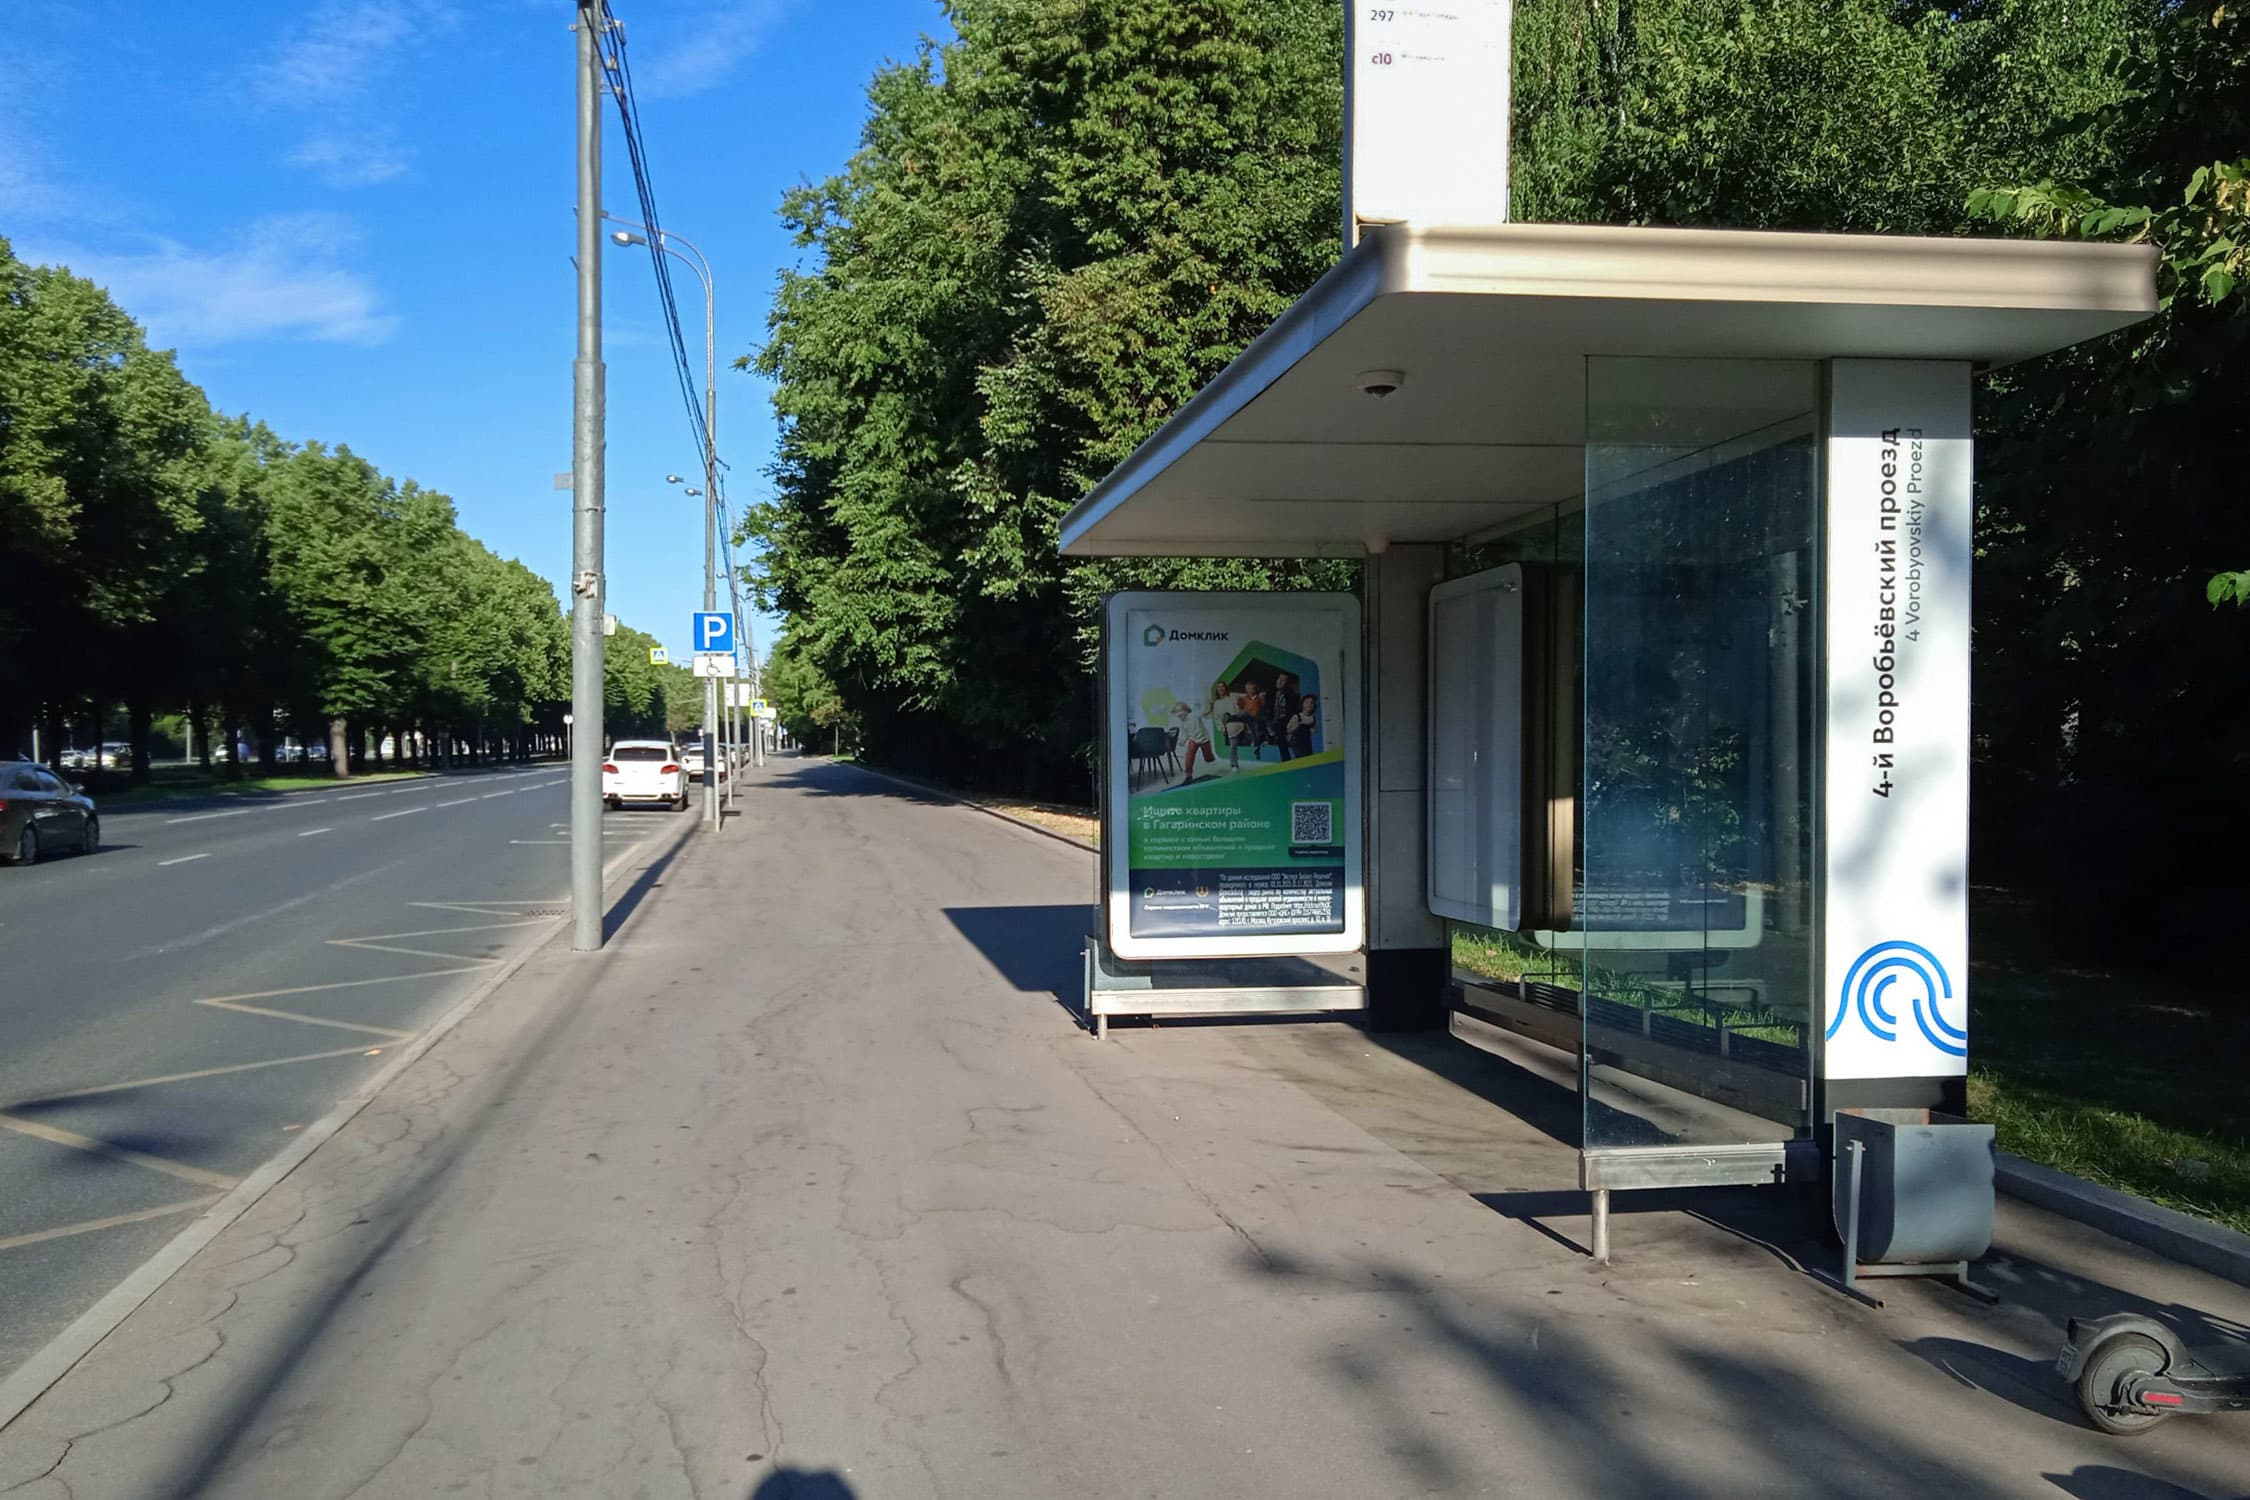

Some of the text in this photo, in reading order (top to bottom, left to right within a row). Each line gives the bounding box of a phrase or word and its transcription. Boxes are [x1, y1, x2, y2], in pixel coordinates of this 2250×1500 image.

[1370, 10, 1394, 22] 297
[1905, 428, 1925, 642] 4 Vorobyovskiy Proezd
[1873, 428, 1902, 798] 4-й Воробьёвский проезд
[704, 616, 727, 649] P
[1169, 629, 1229, 642] Домклик
[1185, 807, 1241, 817] квартиры
[1153, 820, 1227, 831] Гагаринском
[1229, 818, 1271, 831] районе
